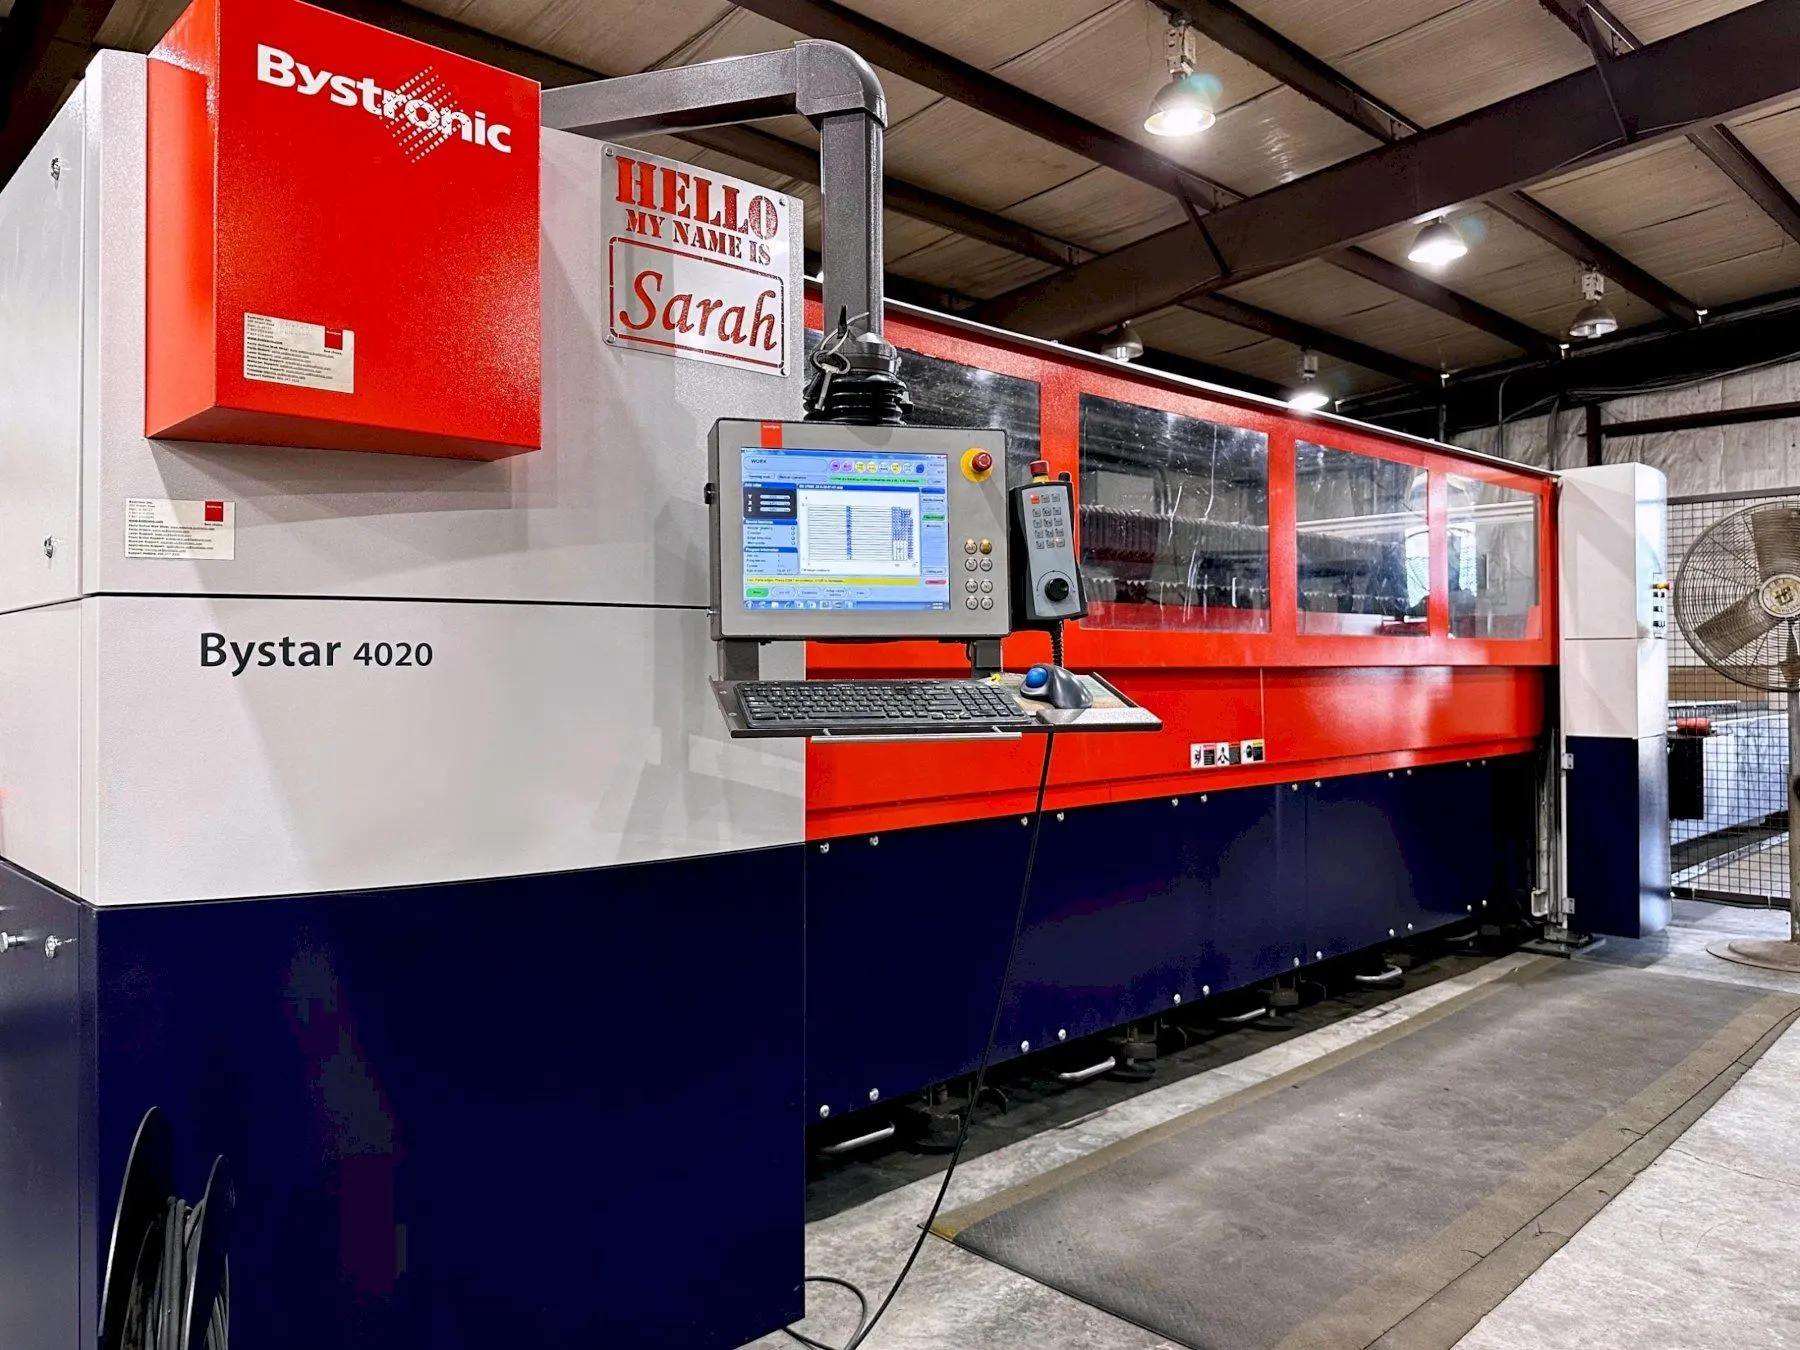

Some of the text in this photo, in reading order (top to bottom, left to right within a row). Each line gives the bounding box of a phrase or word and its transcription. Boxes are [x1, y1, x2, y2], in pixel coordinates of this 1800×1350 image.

[256, 43, 512, 154] Bystronic
[615, 155, 779, 241] HELLO
[625, 208, 771, 266] MY NAME IS
[618, 270, 778, 351] Sarah
[200, 632, 433, 677] Bystar 4020
